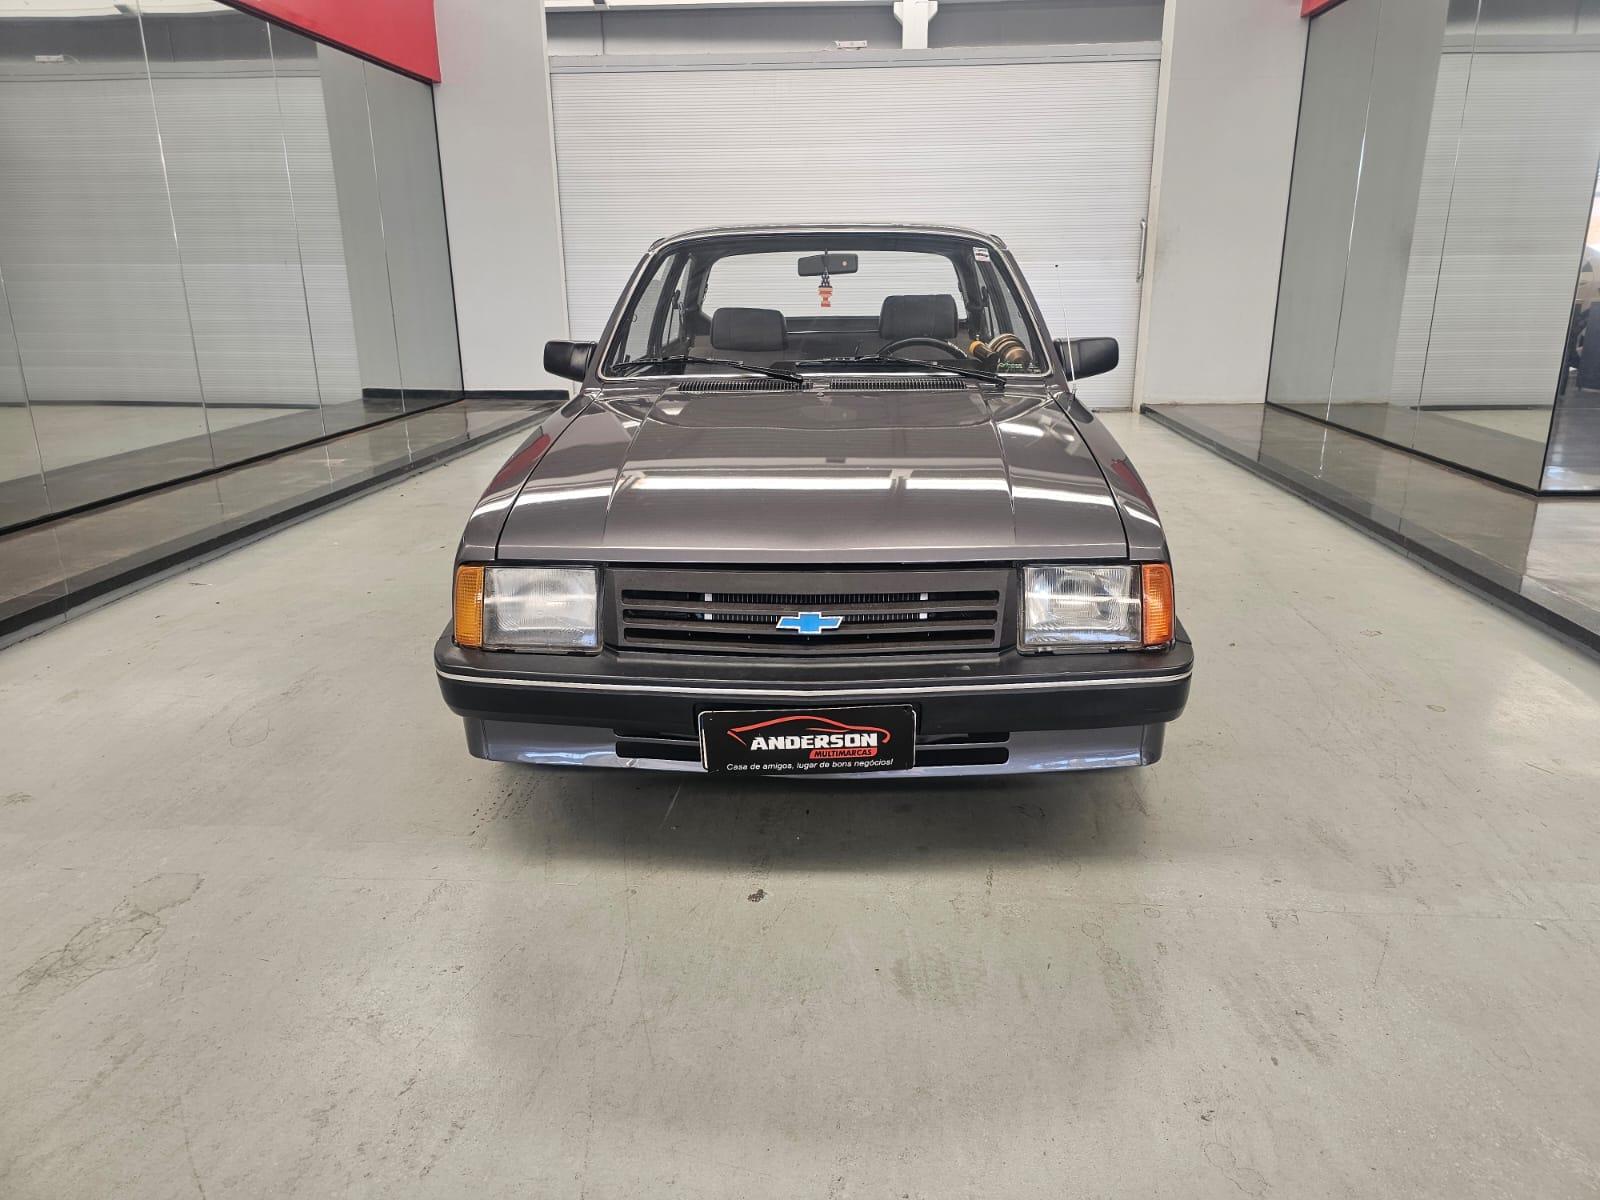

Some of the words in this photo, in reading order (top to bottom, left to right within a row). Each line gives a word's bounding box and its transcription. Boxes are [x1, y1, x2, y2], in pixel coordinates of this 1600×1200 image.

[751, 733, 877, 750] ANDERSON
[814, 749, 872, 758] MULTIMARCAS
[726, 763, 748, 771] Casa
[750, 762, 761, 770] de
[762, 761, 795, 771] amigos,
[796, 761, 818, 770] lugar
[819, 761, 830, 769] de
[832, 760, 852, 768] bons
[854, 758, 894, 767] negócios!
